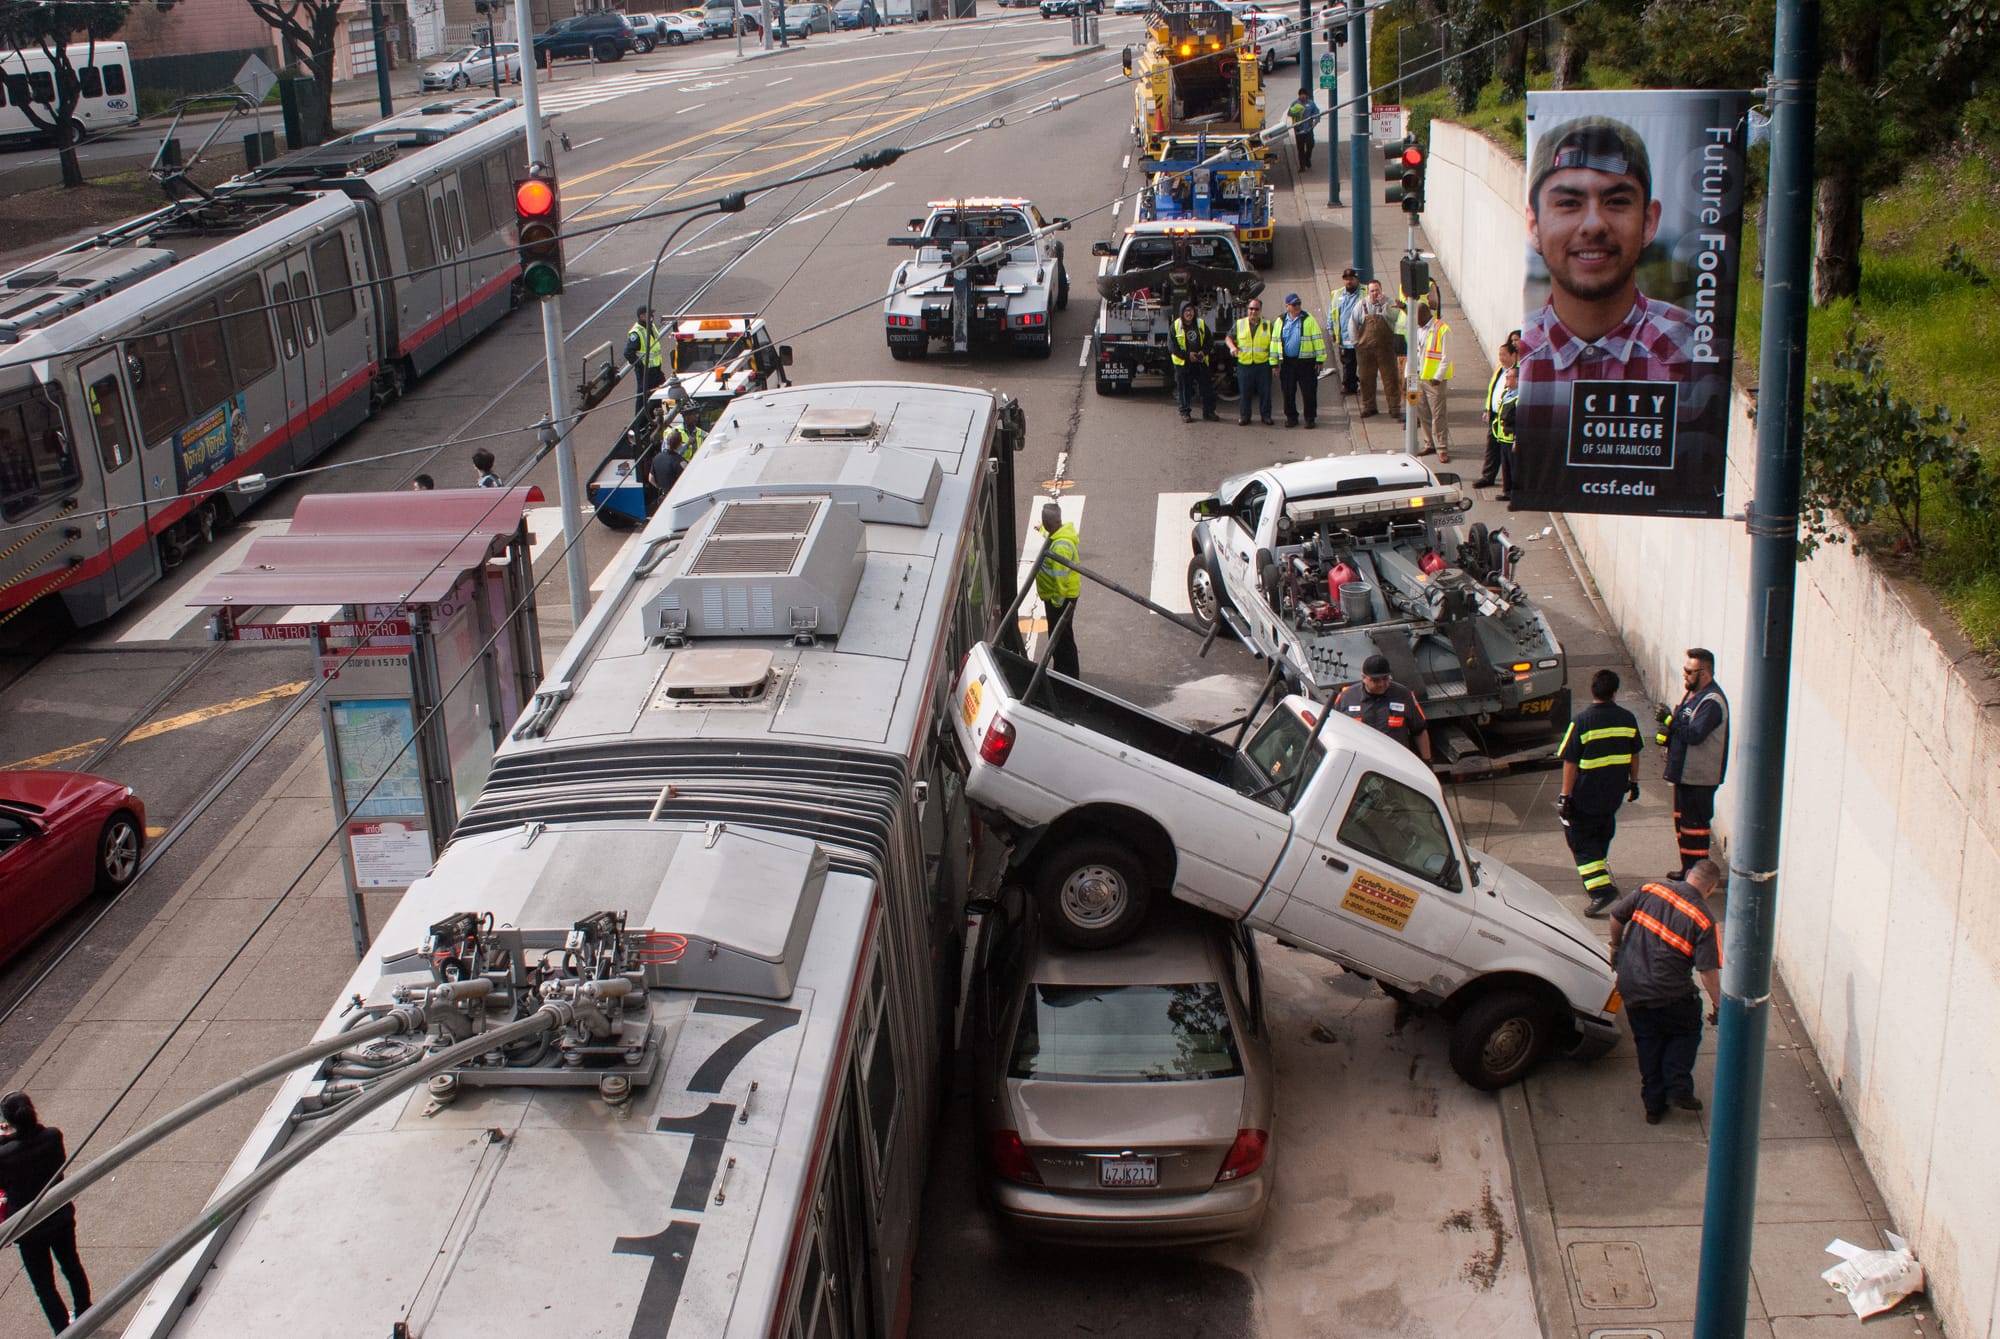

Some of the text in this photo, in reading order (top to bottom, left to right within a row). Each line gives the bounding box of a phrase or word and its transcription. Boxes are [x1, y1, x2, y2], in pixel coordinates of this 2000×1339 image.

[1692, 127, 1732, 363] Future Focused
[1584, 394, 1665, 414] CITY
[1583, 422, 1663, 439] COLLEGE
[1582, 443, 1661, 456] OF SAN FRANCISCO
[1582, 479, 1656, 496] ccsf.edu
[264, 626, 307, 640] METRO
[354, 623, 398, 637] METRO
[1521, 699, 1555, 715] FSW
[1358, 876, 1387, 893] CertaPro
